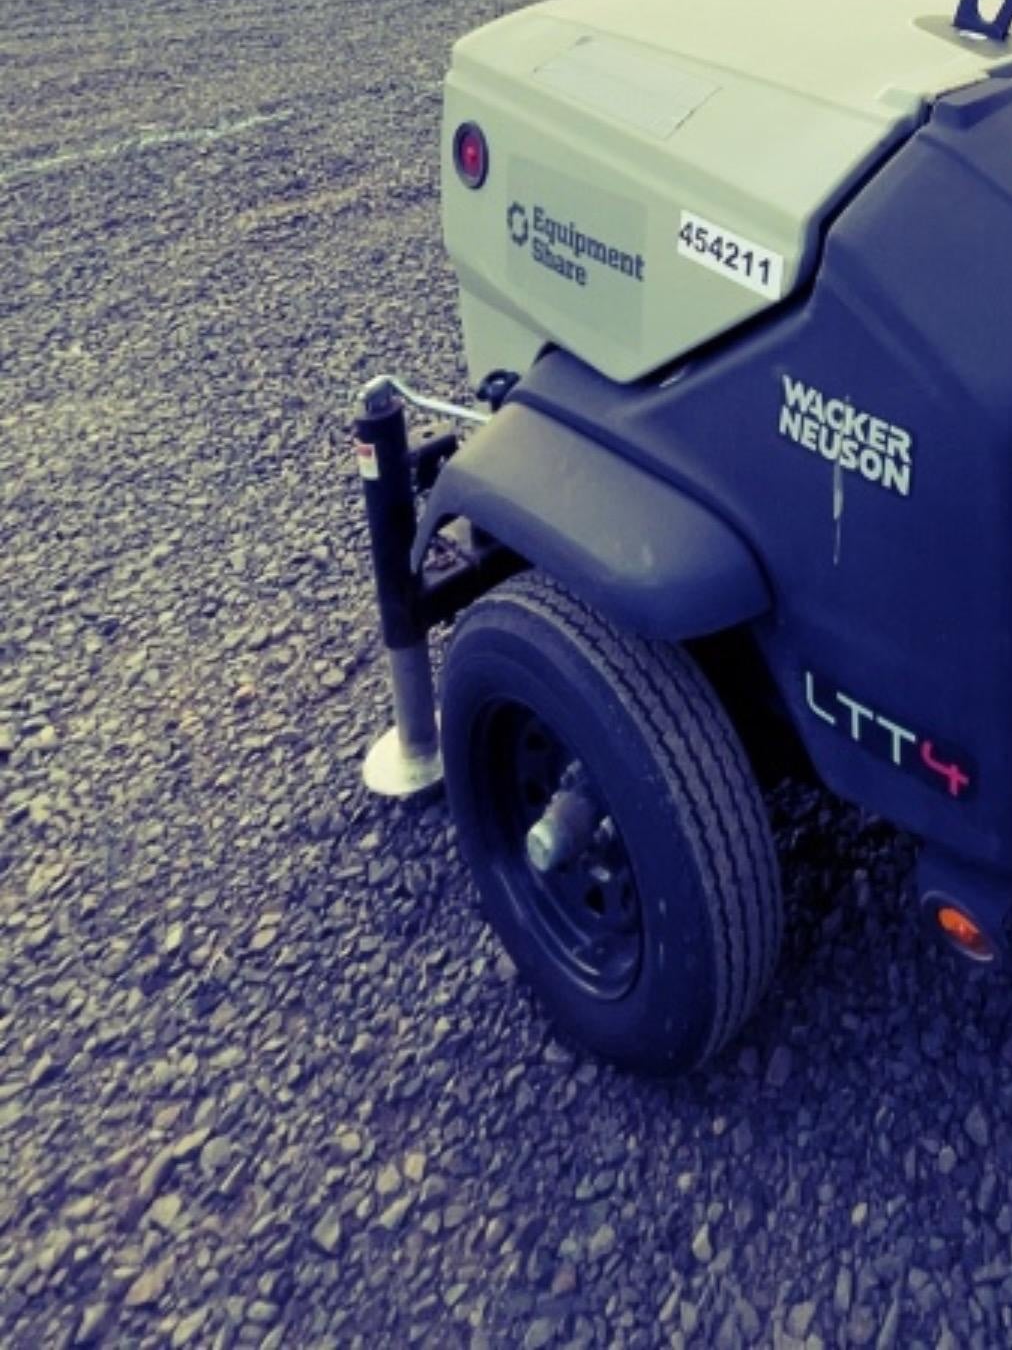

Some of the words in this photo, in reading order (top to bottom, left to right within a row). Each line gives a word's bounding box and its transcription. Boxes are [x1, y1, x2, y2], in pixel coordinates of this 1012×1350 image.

[531, 204, 646, 283] Equipment
[531, 240, 588, 287] Share
[678, 220, 772, 286] 454211
[778, 405, 911, 496] NEUSON
[780, 373, 912, 463] WACKER
[805, 670, 970, 797] LTT4
